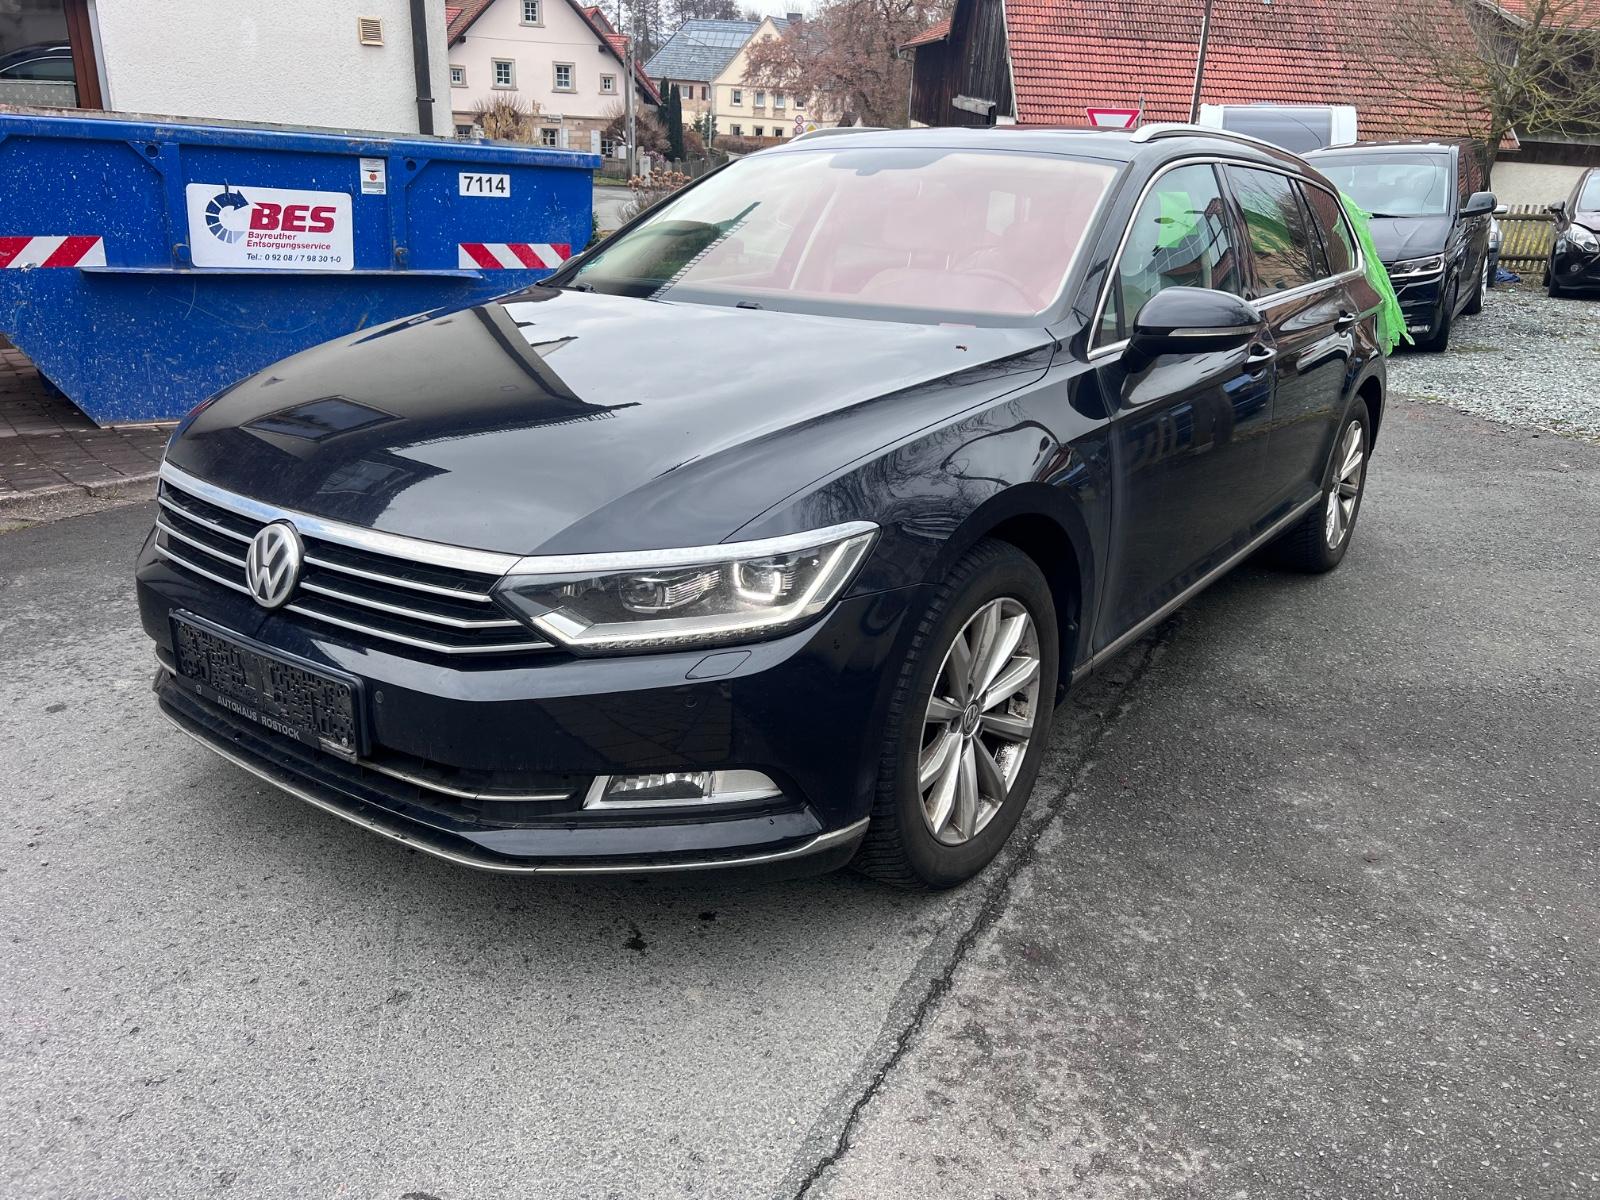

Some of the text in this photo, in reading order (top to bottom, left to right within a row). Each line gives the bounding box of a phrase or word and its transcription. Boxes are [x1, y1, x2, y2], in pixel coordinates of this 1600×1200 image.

[464, 175, 506, 193] 7114
[249, 202, 337, 233] BES
[248, 231, 297, 241] Bayreuther
[246, 240, 331, 250] Entsorgungsservice
[247, 253, 262, 261] Tel.:
[264, 253, 270, 261] 0
[271, 253, 281, 261] 92
[318, 255, 328, 263] 30
[217, 695, 300, 740] AUTOHAUS ROSTOCK
